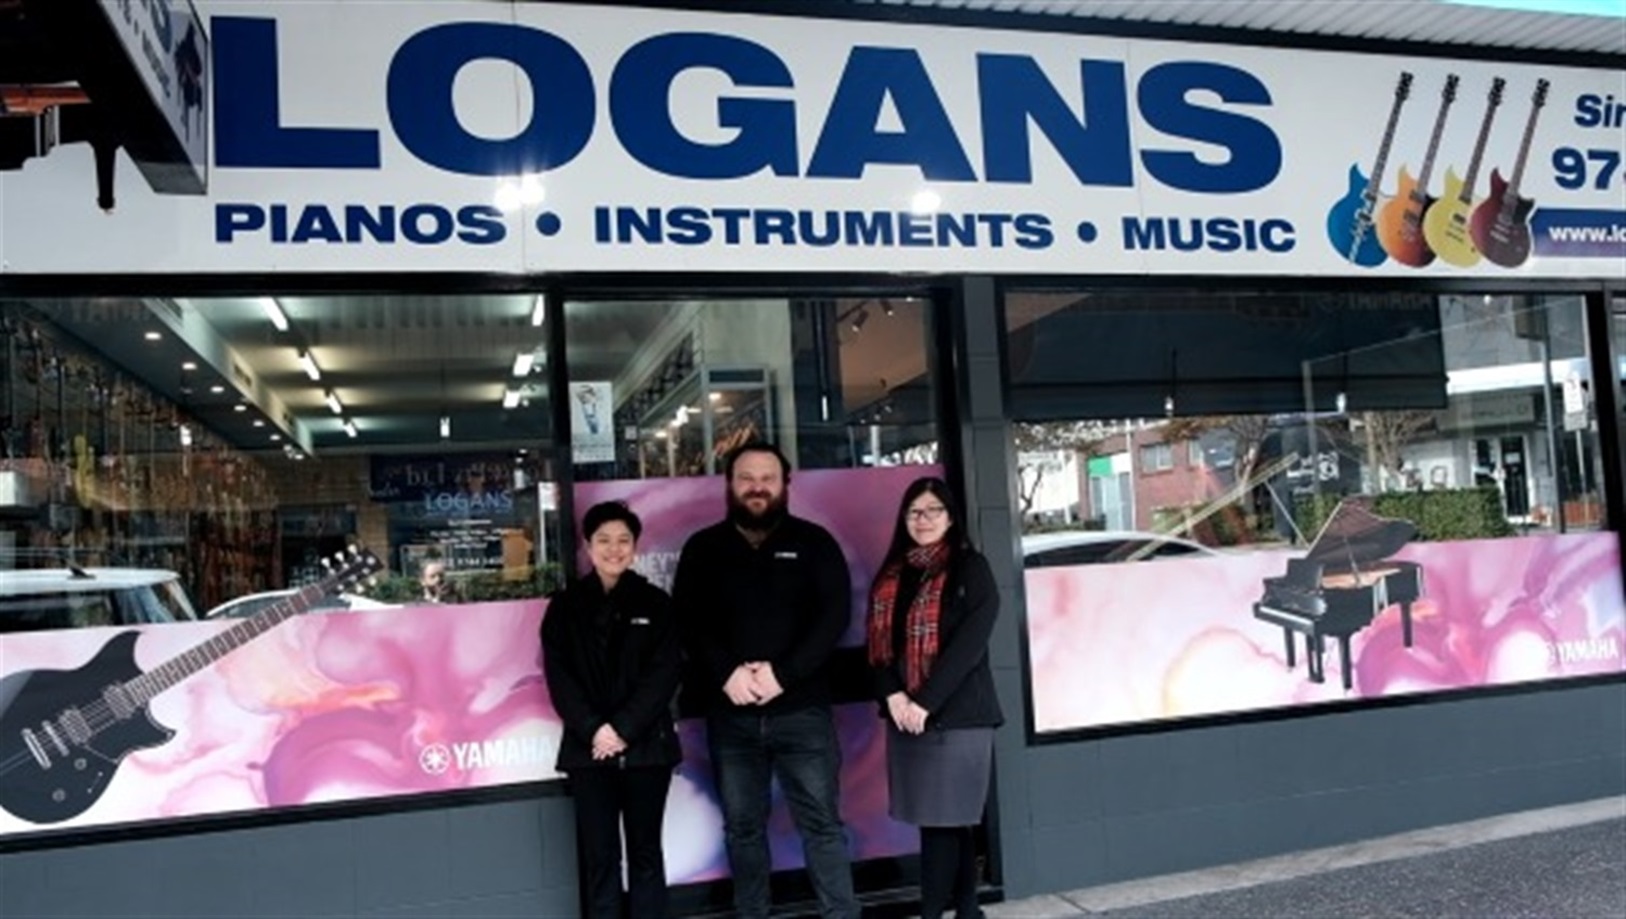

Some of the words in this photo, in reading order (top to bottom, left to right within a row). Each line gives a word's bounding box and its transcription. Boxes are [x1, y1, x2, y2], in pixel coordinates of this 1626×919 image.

[210, 16, 1282, 194] LOGANS
[1552, 147, 1626, 190] 97
[215, 203, 507, 245] PIANOS
[595, 206, 1053, 249] INSTRUMENTS
[1123, 216, 1297, 253] MUSIC
[425, 490, 513, 511] LOGANS
[1558, 637, 1619, 663] YAMAHA
[453, 736, 553, 770] YAMAHA
